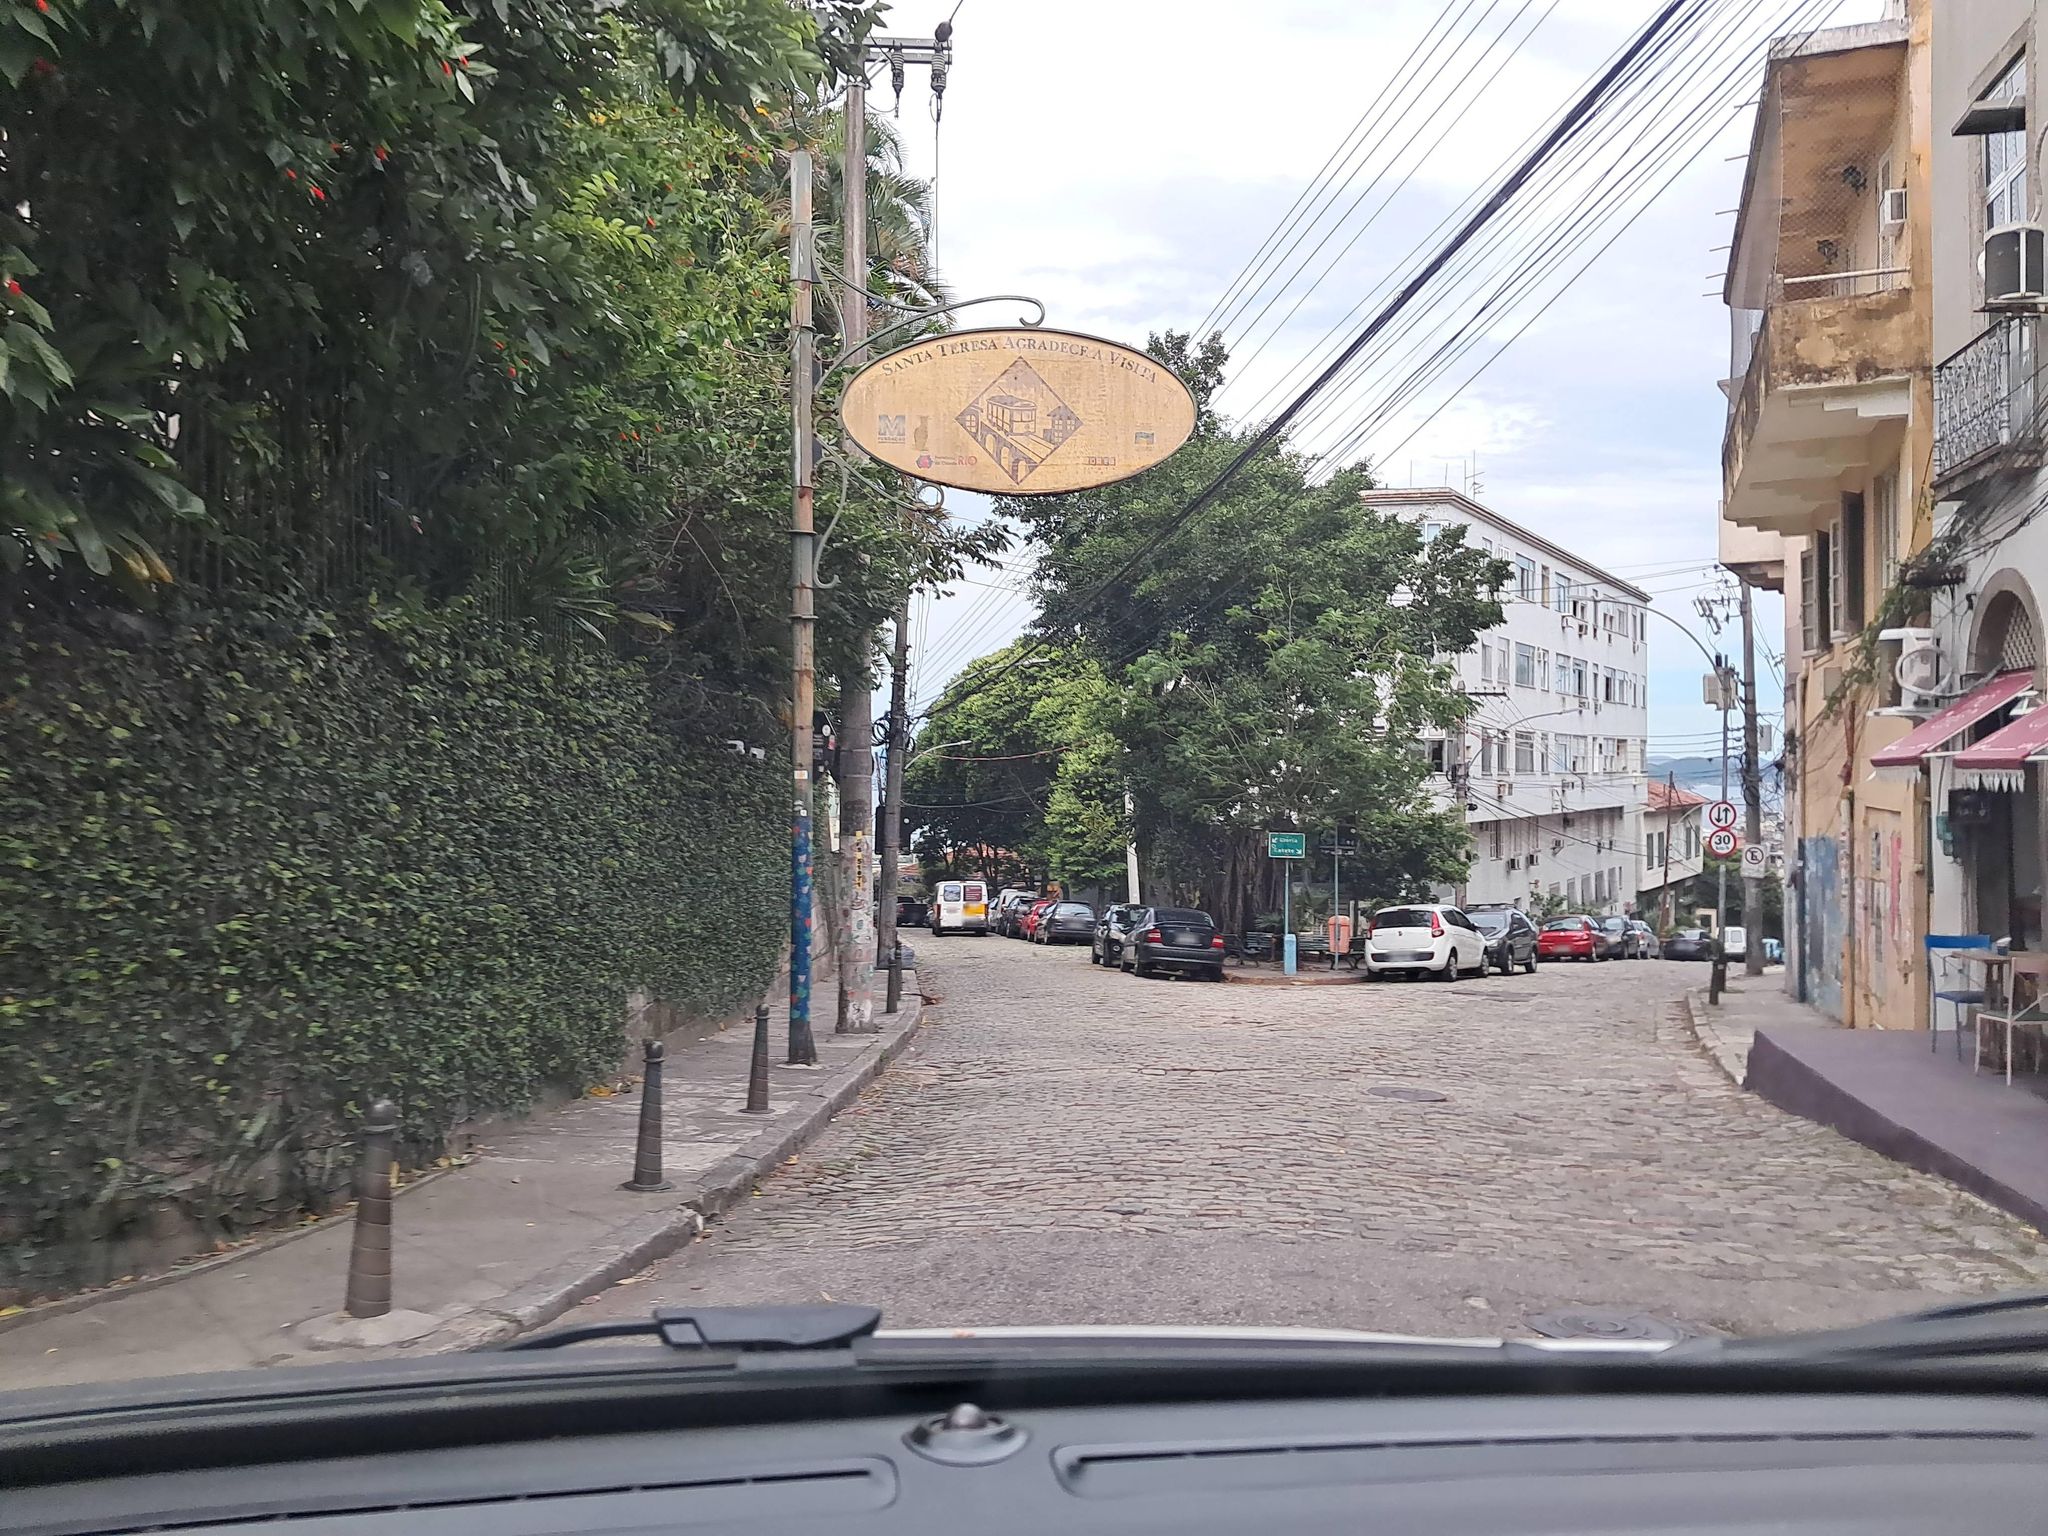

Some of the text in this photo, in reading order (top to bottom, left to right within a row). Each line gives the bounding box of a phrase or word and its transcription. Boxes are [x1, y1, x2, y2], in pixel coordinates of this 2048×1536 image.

[881, 336, 1159, 383] SANTA TERESA AGRADECE A VISITA
[1714, 834, 1731, 845] 30
